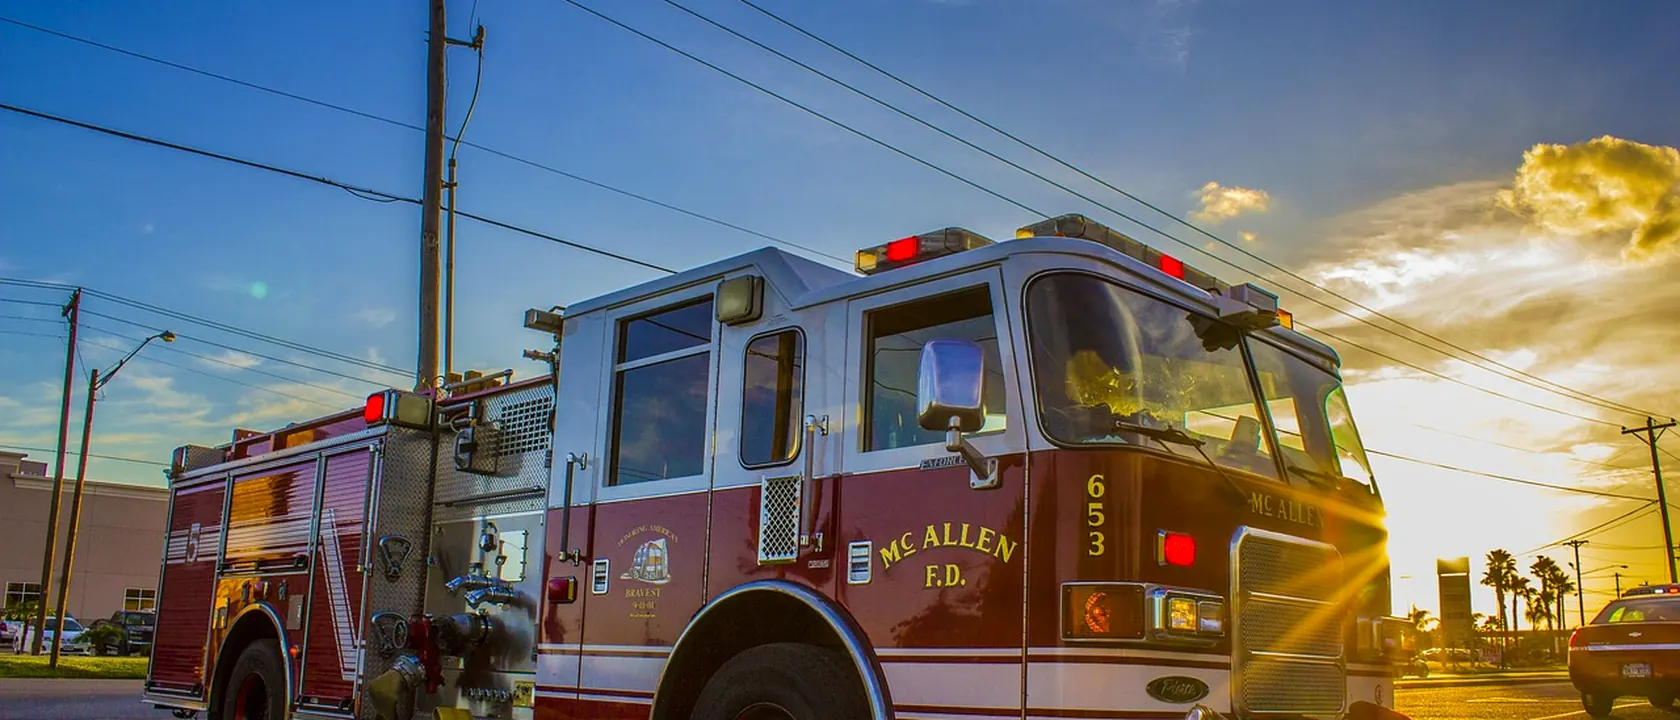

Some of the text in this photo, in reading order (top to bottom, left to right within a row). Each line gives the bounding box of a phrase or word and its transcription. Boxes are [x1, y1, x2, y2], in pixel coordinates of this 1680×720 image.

[920, 455, 968, 470] ENFORCE
[1087, 474, 1105, 556] 653
[922, 522, 1018, 563] ALLEN
[925, 564, 966, 587] F.D.
